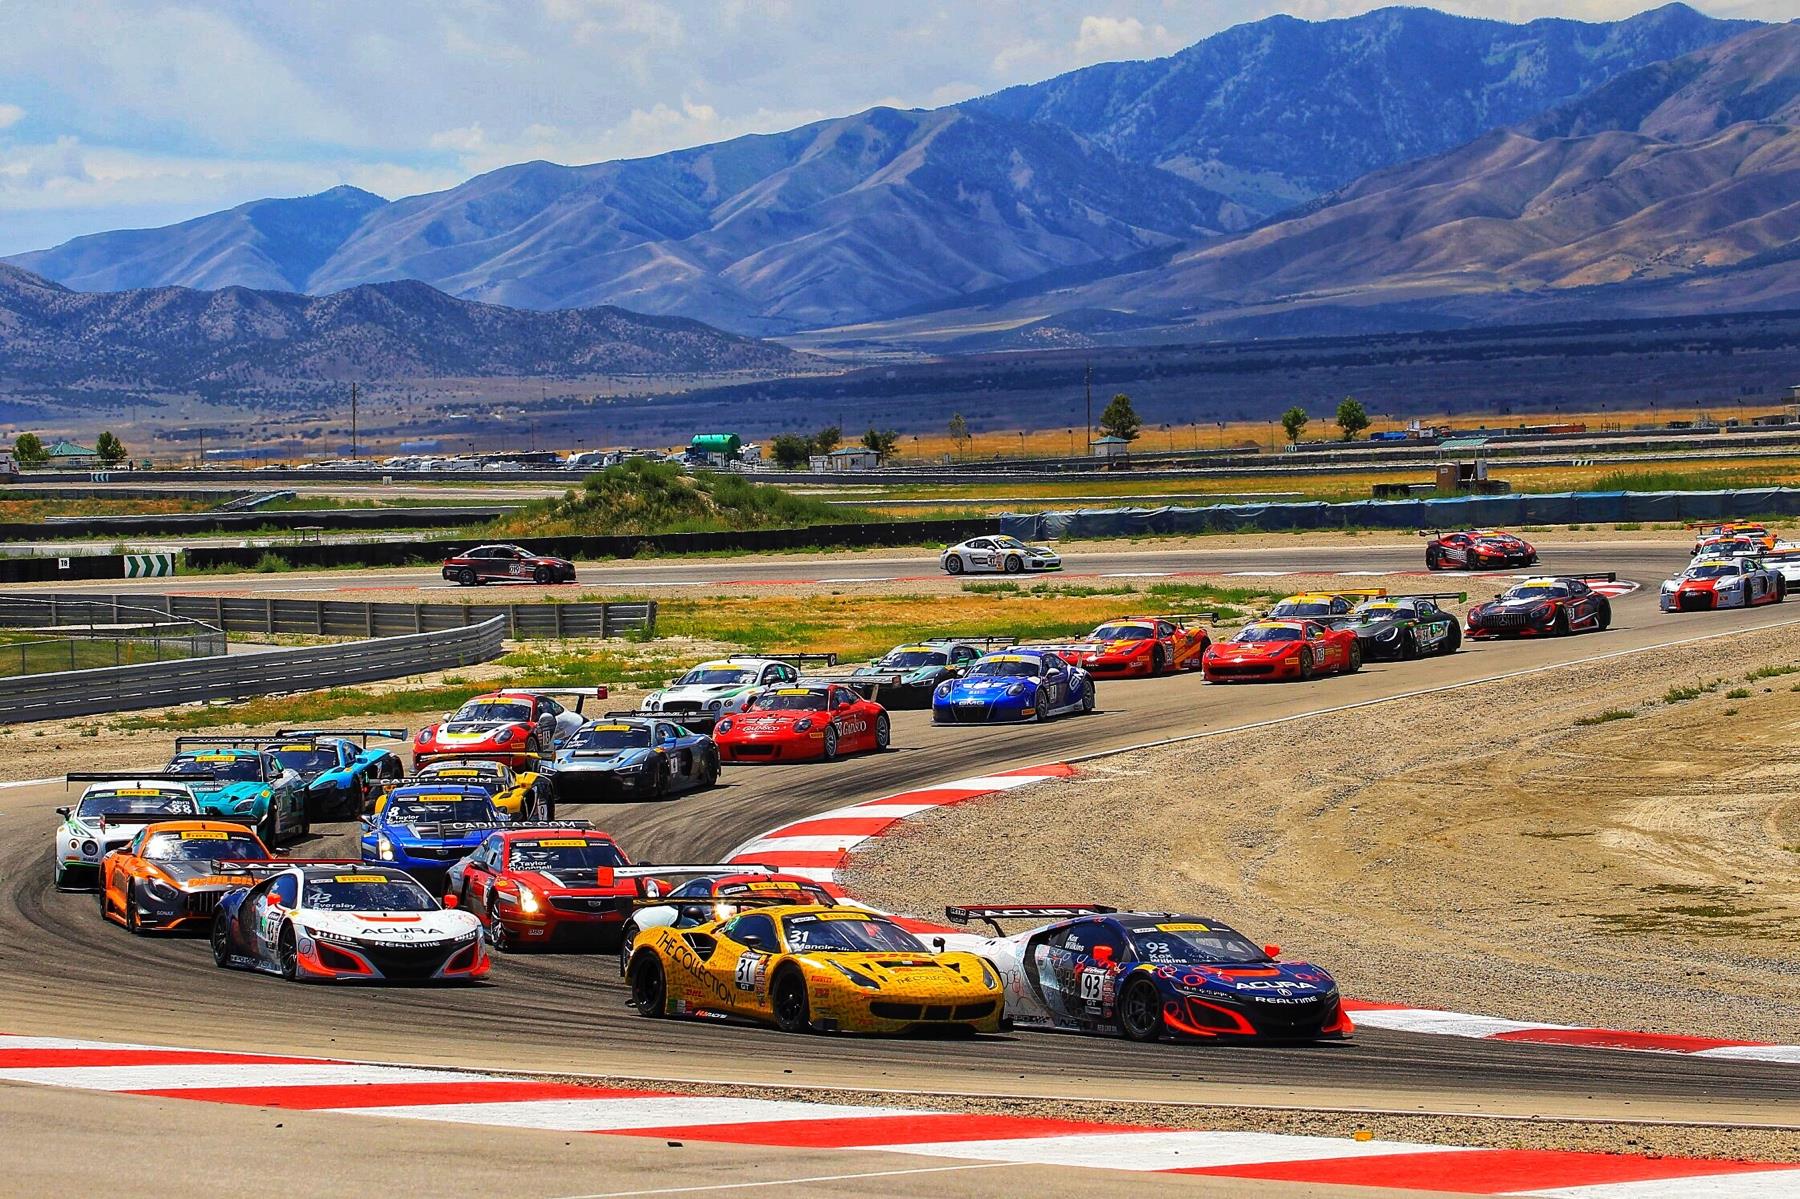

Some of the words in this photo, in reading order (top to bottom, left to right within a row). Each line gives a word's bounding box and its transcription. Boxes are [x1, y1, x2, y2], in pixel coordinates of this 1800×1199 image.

[387, 806, 400, 817] 8
[452, 821, 577, 830] CADILLAC.COM
[510, 851, 522, 864] 3
[361, 927, 444, 935] ACURA
[789, 930, 809, 943] 31
[1145, 941, 1170, 954] 93
[737, 959, 753, 982] 31
[1084, 975, 1101, 998] 93
[1236, 981, 1317, 990] ACURA
[1255, 996, 1318, 1004] REALTIME
